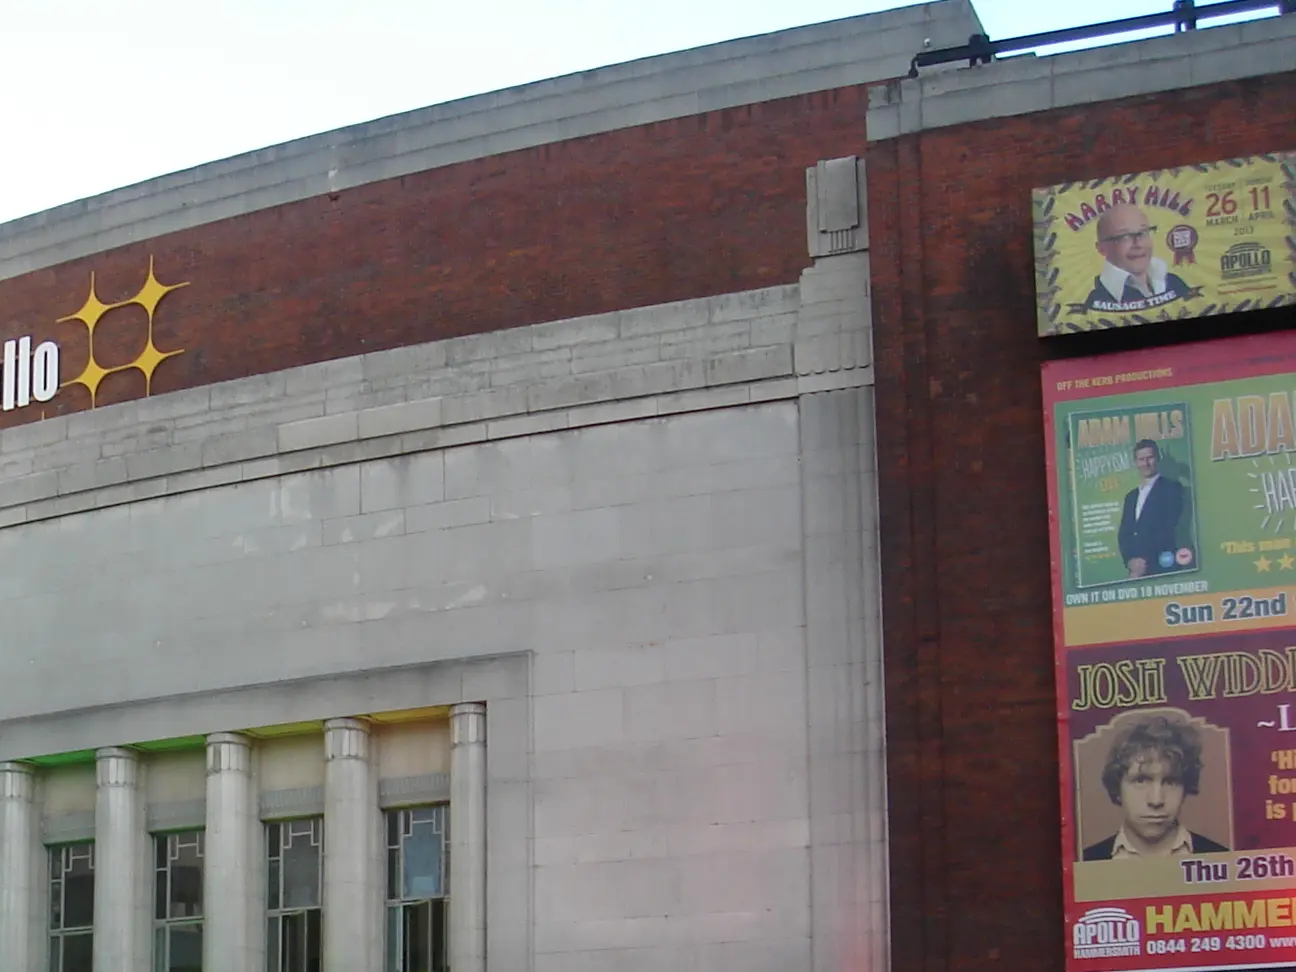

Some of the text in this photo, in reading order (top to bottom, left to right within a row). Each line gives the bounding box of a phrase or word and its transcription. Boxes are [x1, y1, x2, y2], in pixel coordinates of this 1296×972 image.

[1064, 185, 1194, 232] HARRY HILL
[1205, 186, 1271, 217] 26 11
[1206, 215, 1239, 227] MARCH
[1220, 249, 1271, 270] APOLLO
[1092, 290, 1177, 311] SAUSAGE TIME
[1056, 379, 1072, 391] OFF
[1075, 378, 1090, 389] THE
[1078, 416, 1131, 449] ADAM
[1210, 391, 1296, 461] ADA
[1066, 594, 1089, 606] OWN
[1090, 592, 1100, 603] IT
[1102, 590, 1116, 601] ON
[1118, 588, 1138, 600] DVD
[1154, 580, 1208, 596] NOVEMBER
[1165, 592, 1287, 627] Sun 22nd
[1072, 658, 1167, 711] JOSH
[1265, 799, 1286, 820] is
[1181, 853, 1295, 883] Thu 26th
[1073, 897, 1296, 945] APOLLO HAMME
[1074, 946, 1140, 959] HAMMERSMITH
[1146, 939, 1186, 955] 0844
[1191, 936, 1221, 953] 249
[1225, 934, 1266, 951] 4300
